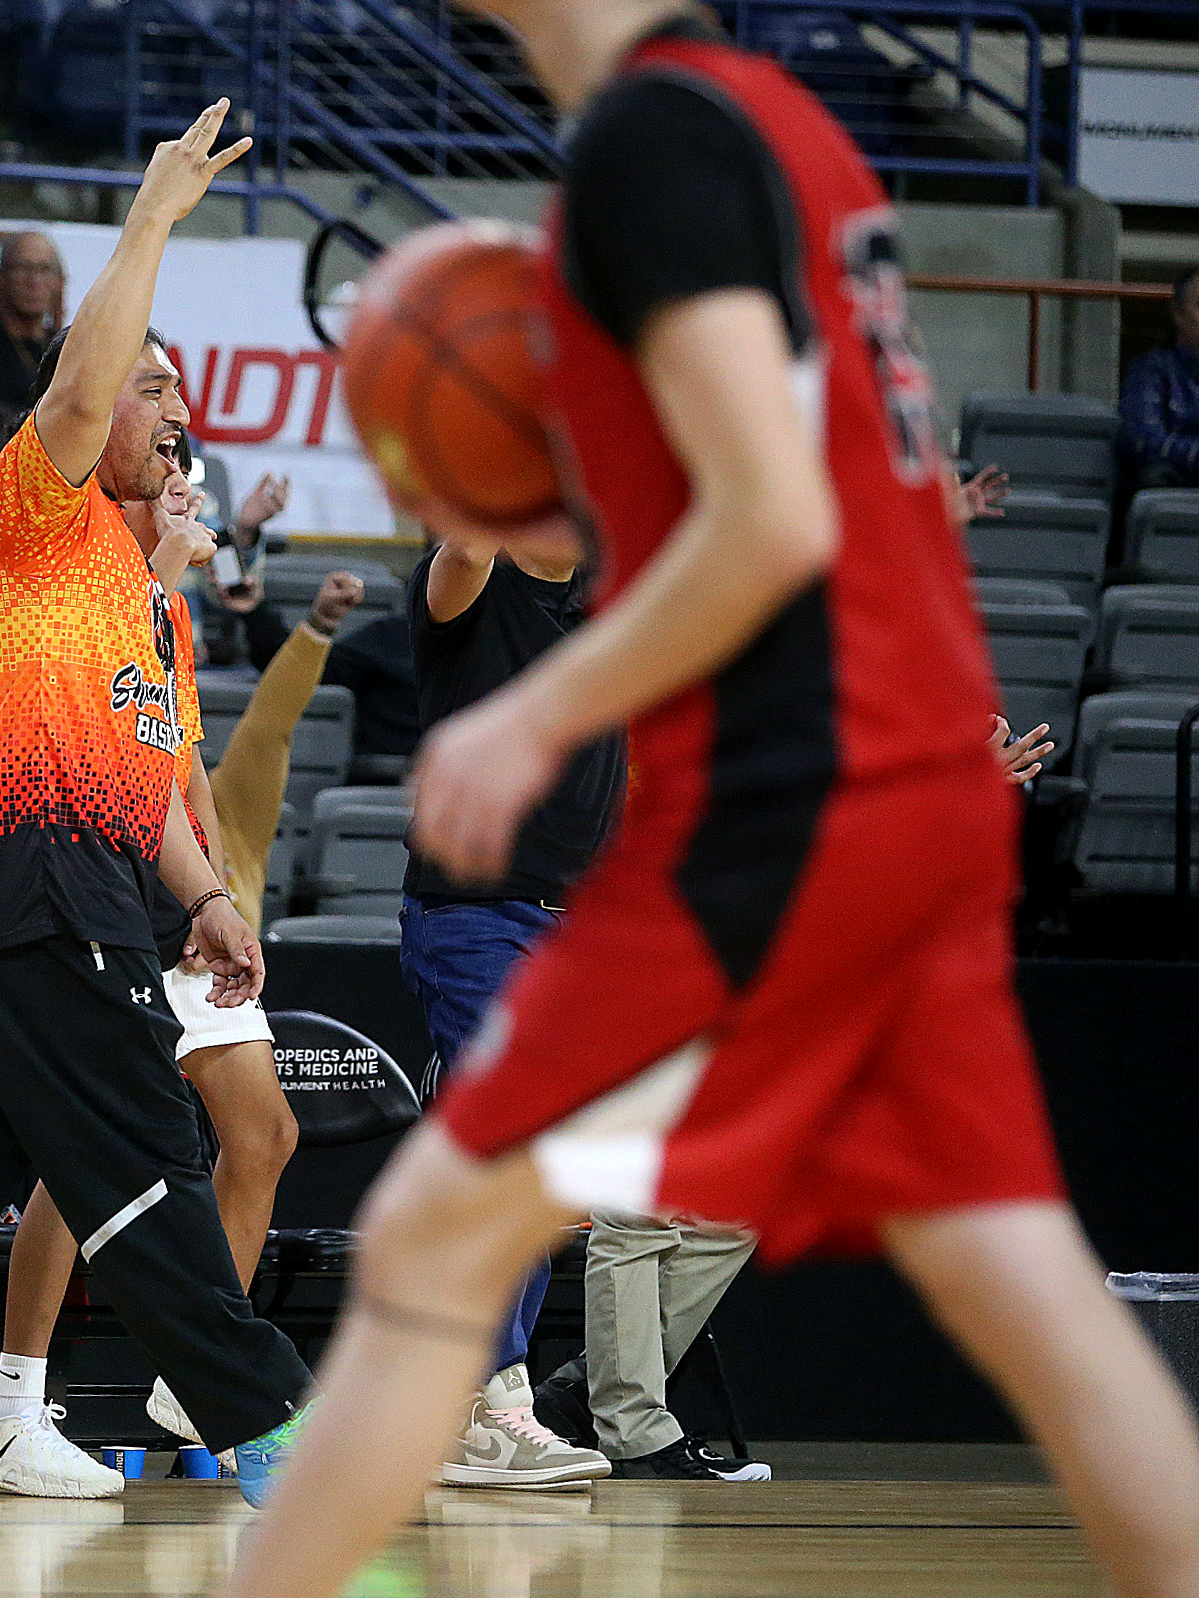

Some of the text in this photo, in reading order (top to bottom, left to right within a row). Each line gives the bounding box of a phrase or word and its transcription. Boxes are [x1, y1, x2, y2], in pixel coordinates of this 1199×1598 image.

[273, 1048, 378, 1062] OPEDICS AND
[275, 1061, 379, 1076] TS MEDICINE
[332, 1079, 386, 1091] HEALTH
